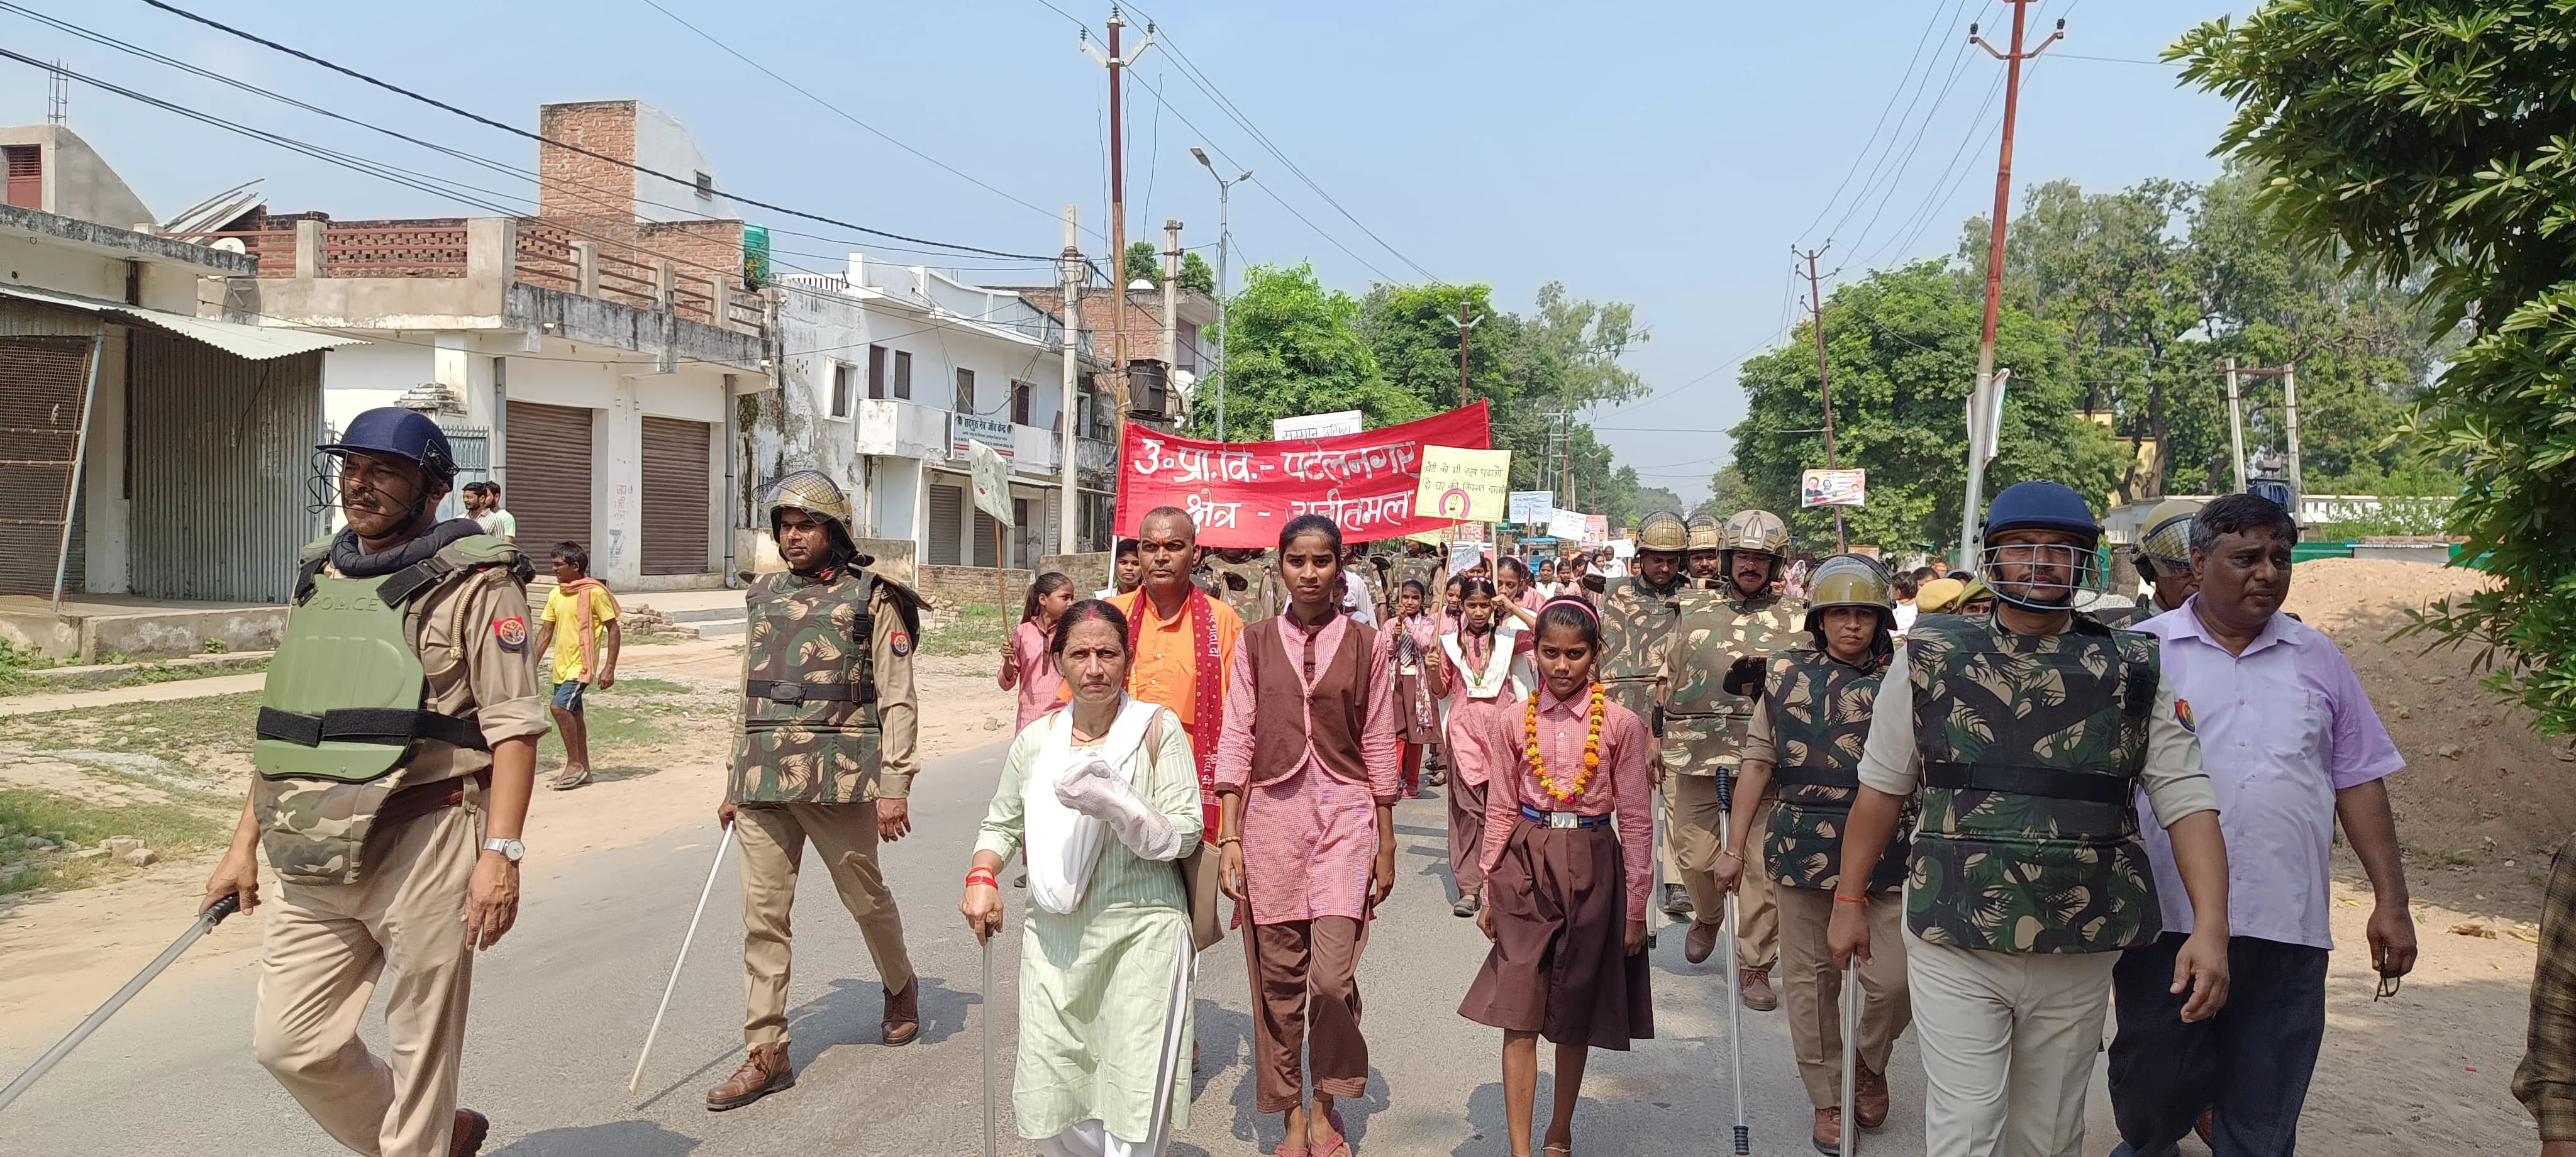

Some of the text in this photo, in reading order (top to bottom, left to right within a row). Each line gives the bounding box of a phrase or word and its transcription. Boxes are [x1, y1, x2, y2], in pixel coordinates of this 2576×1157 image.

[1280, 439, 1421, 485] पटेलनगर
[1440, 462, 1450, 473] को
[1436, 482, 1445, 492] घर
[309, 597, 380, 612] POLICE
